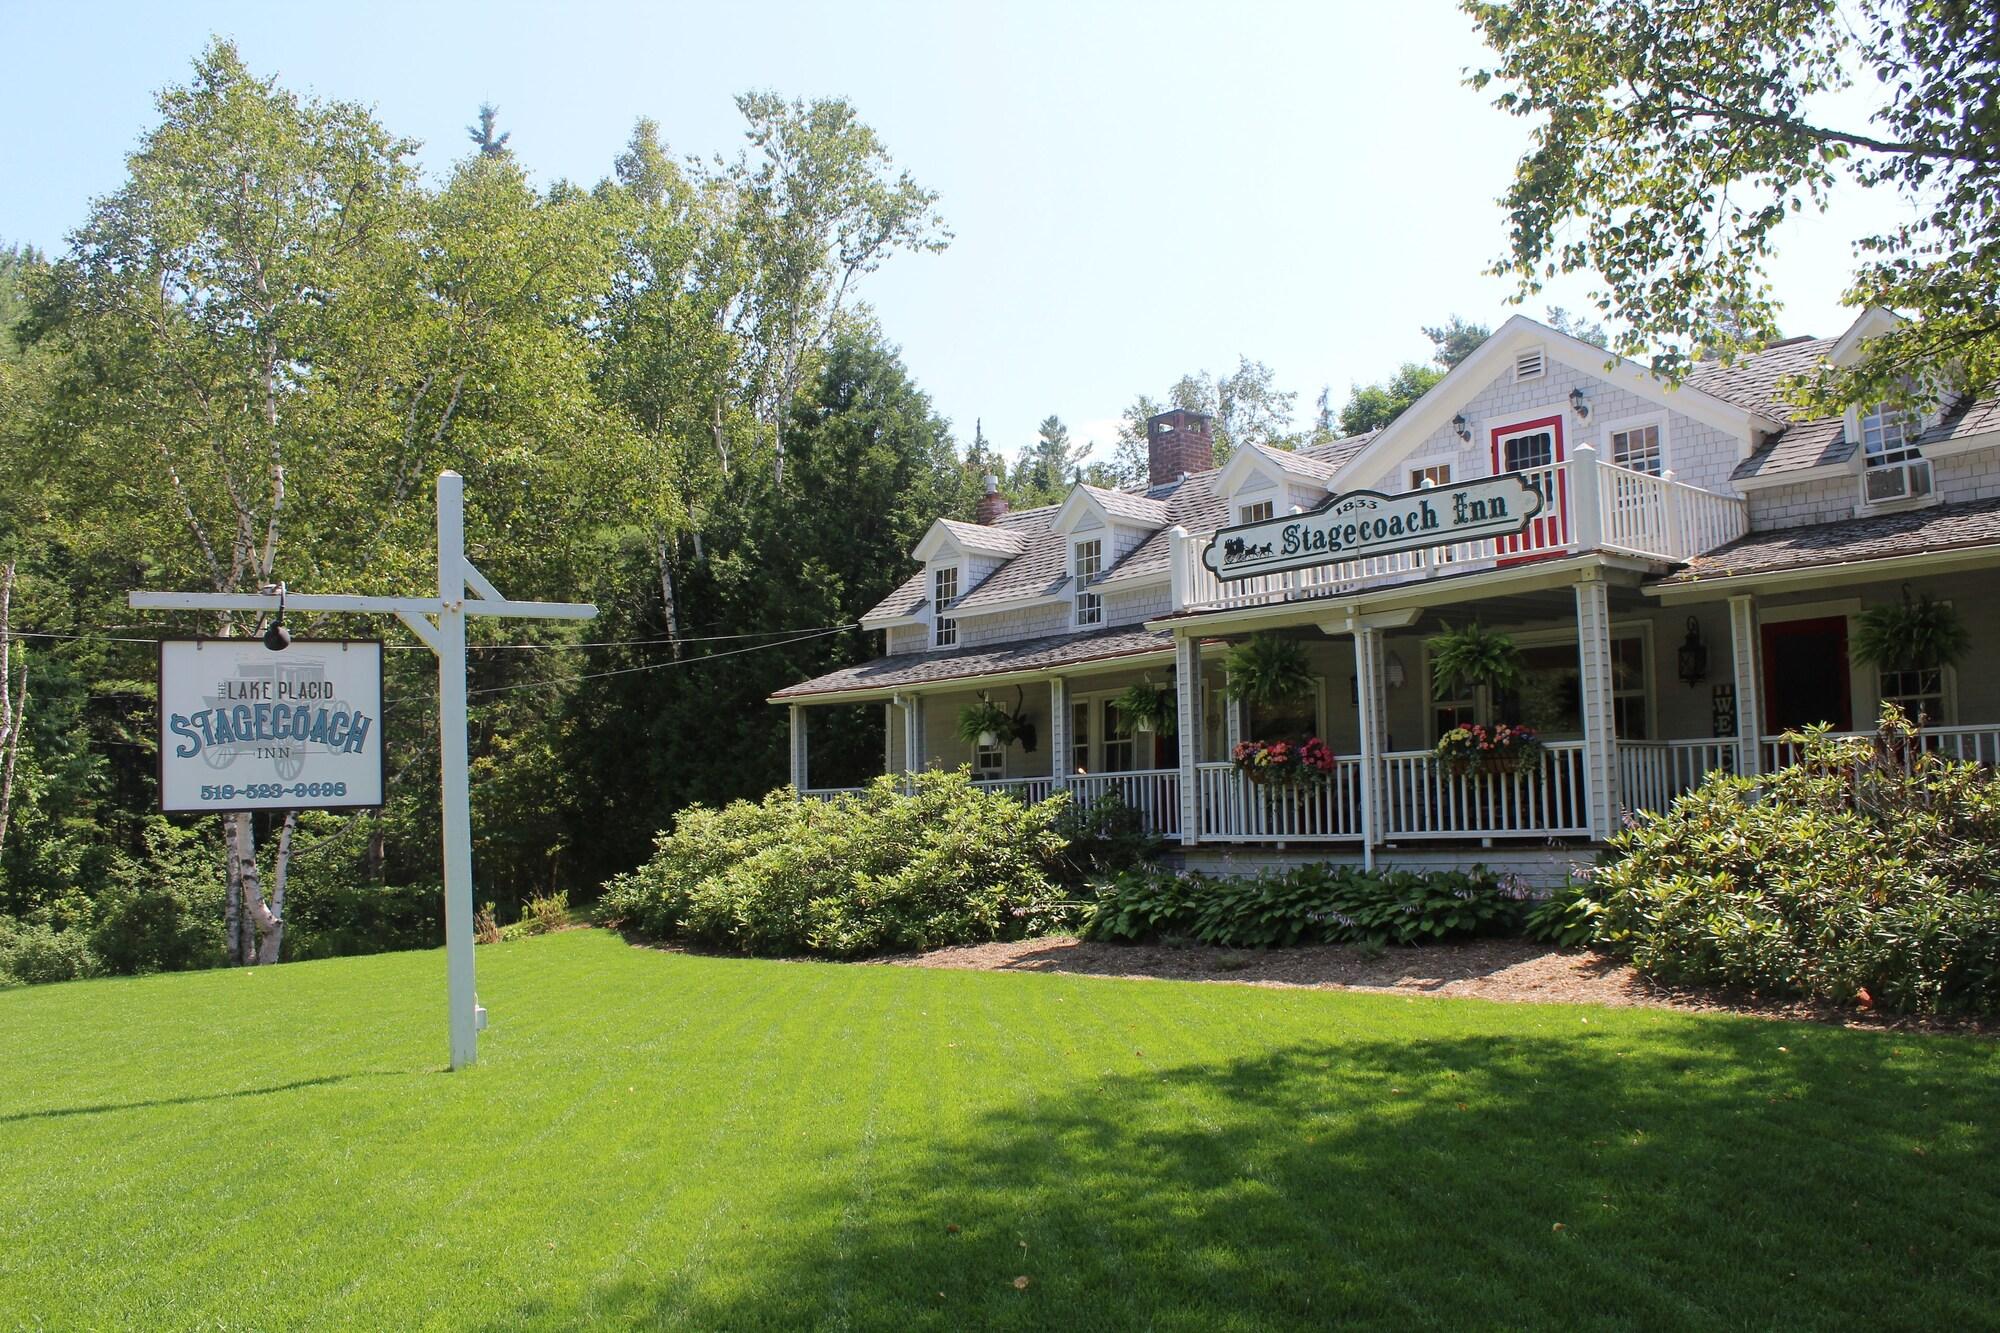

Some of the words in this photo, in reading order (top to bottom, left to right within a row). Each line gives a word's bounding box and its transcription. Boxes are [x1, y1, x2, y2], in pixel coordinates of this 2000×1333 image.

[1335, 499, 1377, 516] 1833
[1280, 500, 1439, 555] Stagecoach
[1452, 492, 1508, 525] Inn
[217, 681, 227, 700] THE
[227, 681, 272, 700] LAKE
[278, 681, 333, 700] PLACID
[170, 702, 373, 759] STAGECOACH
[256, 747, 290, 759] INN
